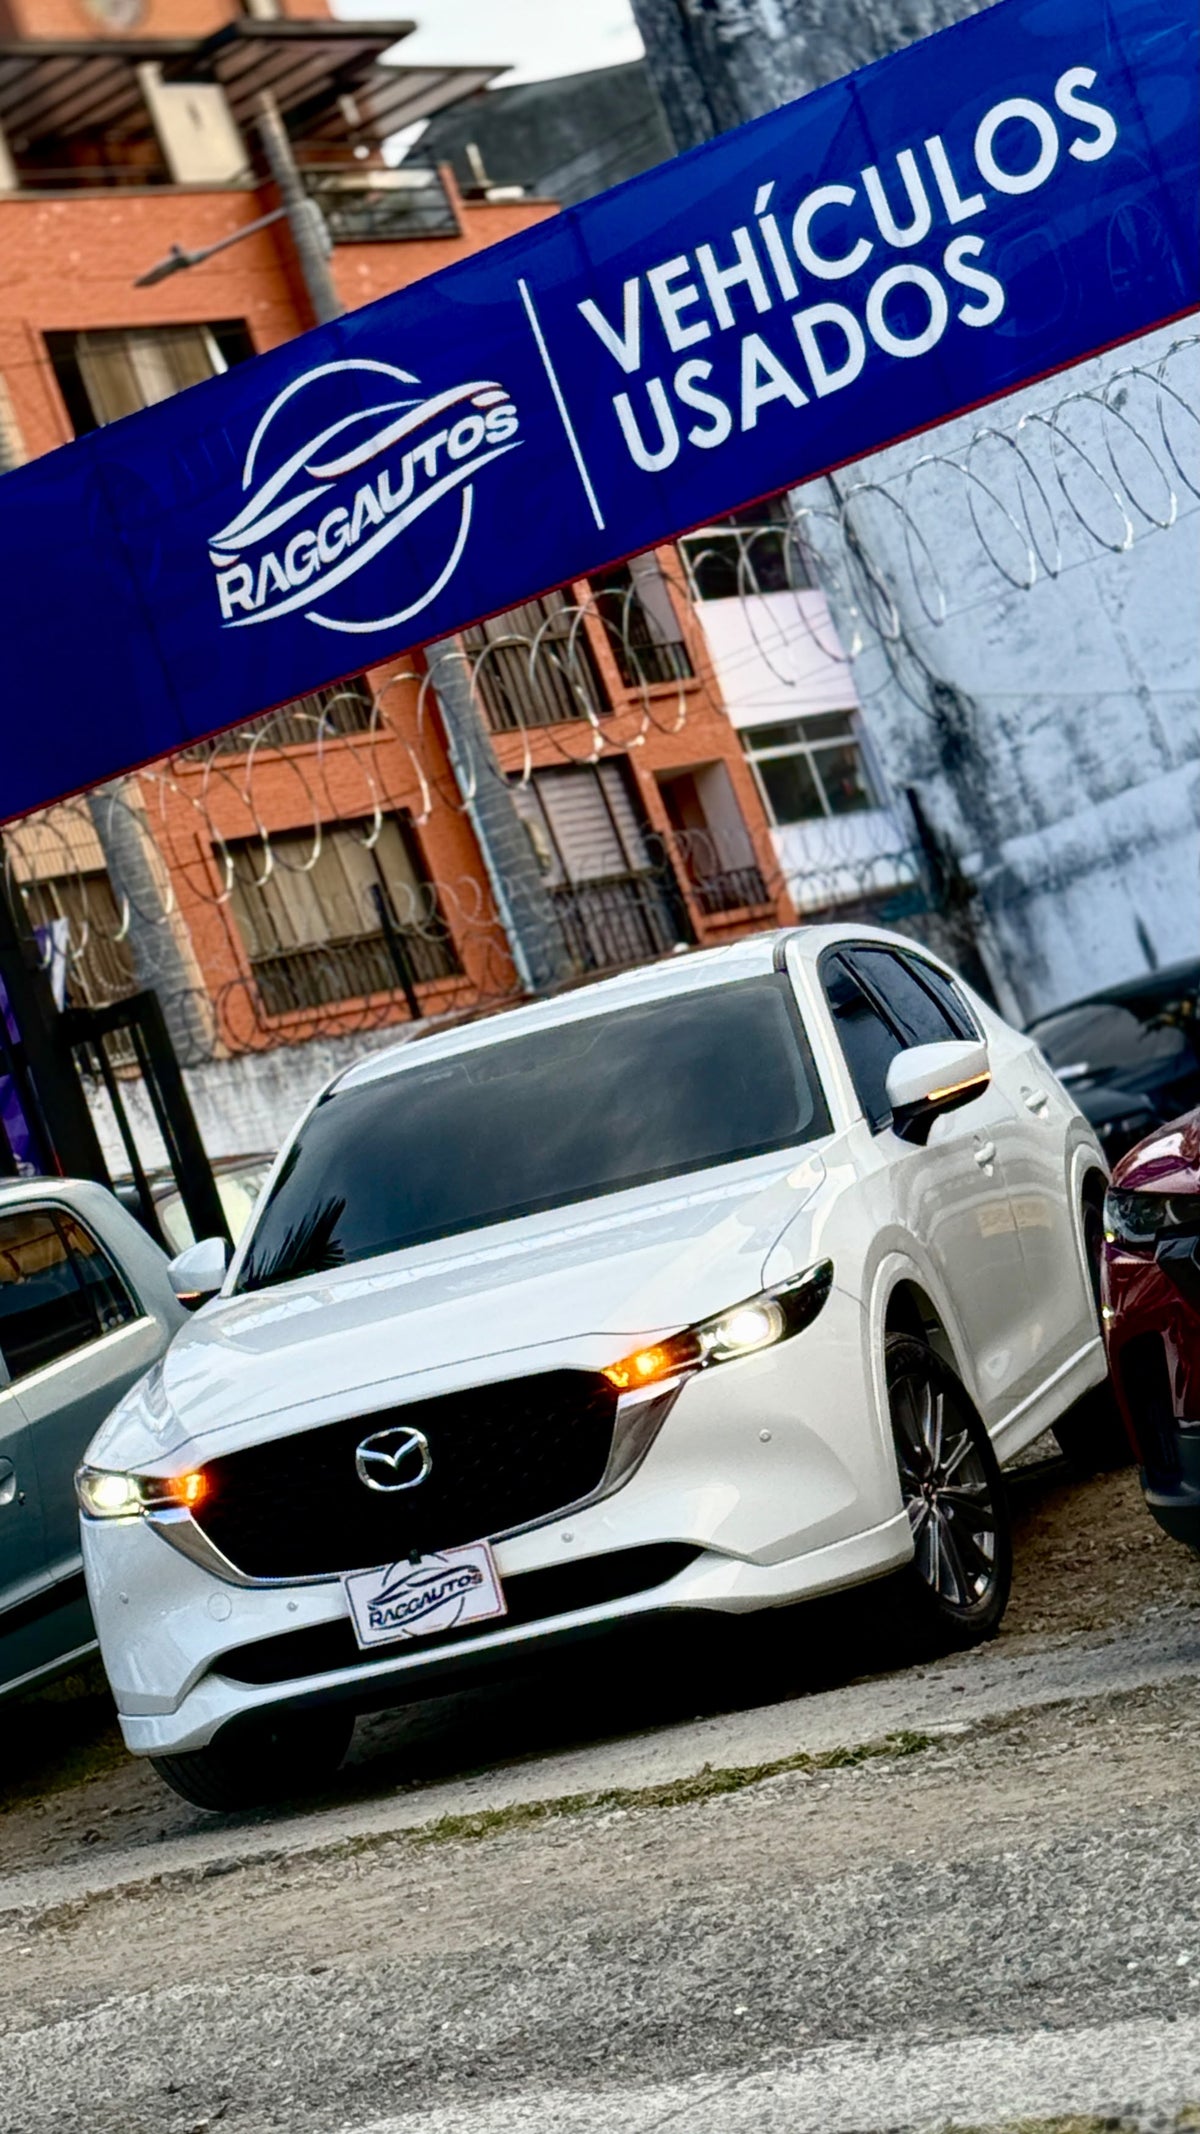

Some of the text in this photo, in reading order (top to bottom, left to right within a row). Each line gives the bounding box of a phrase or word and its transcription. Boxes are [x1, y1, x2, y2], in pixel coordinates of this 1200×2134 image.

[577, 66, 1117, 374] VEHÍCULOS
[612, 235, 1005, 472] USADOS
[216, 405, 519, 619] RAGGAUTOS
[369, 1571, 484, 1628] RAGGAUTOS
